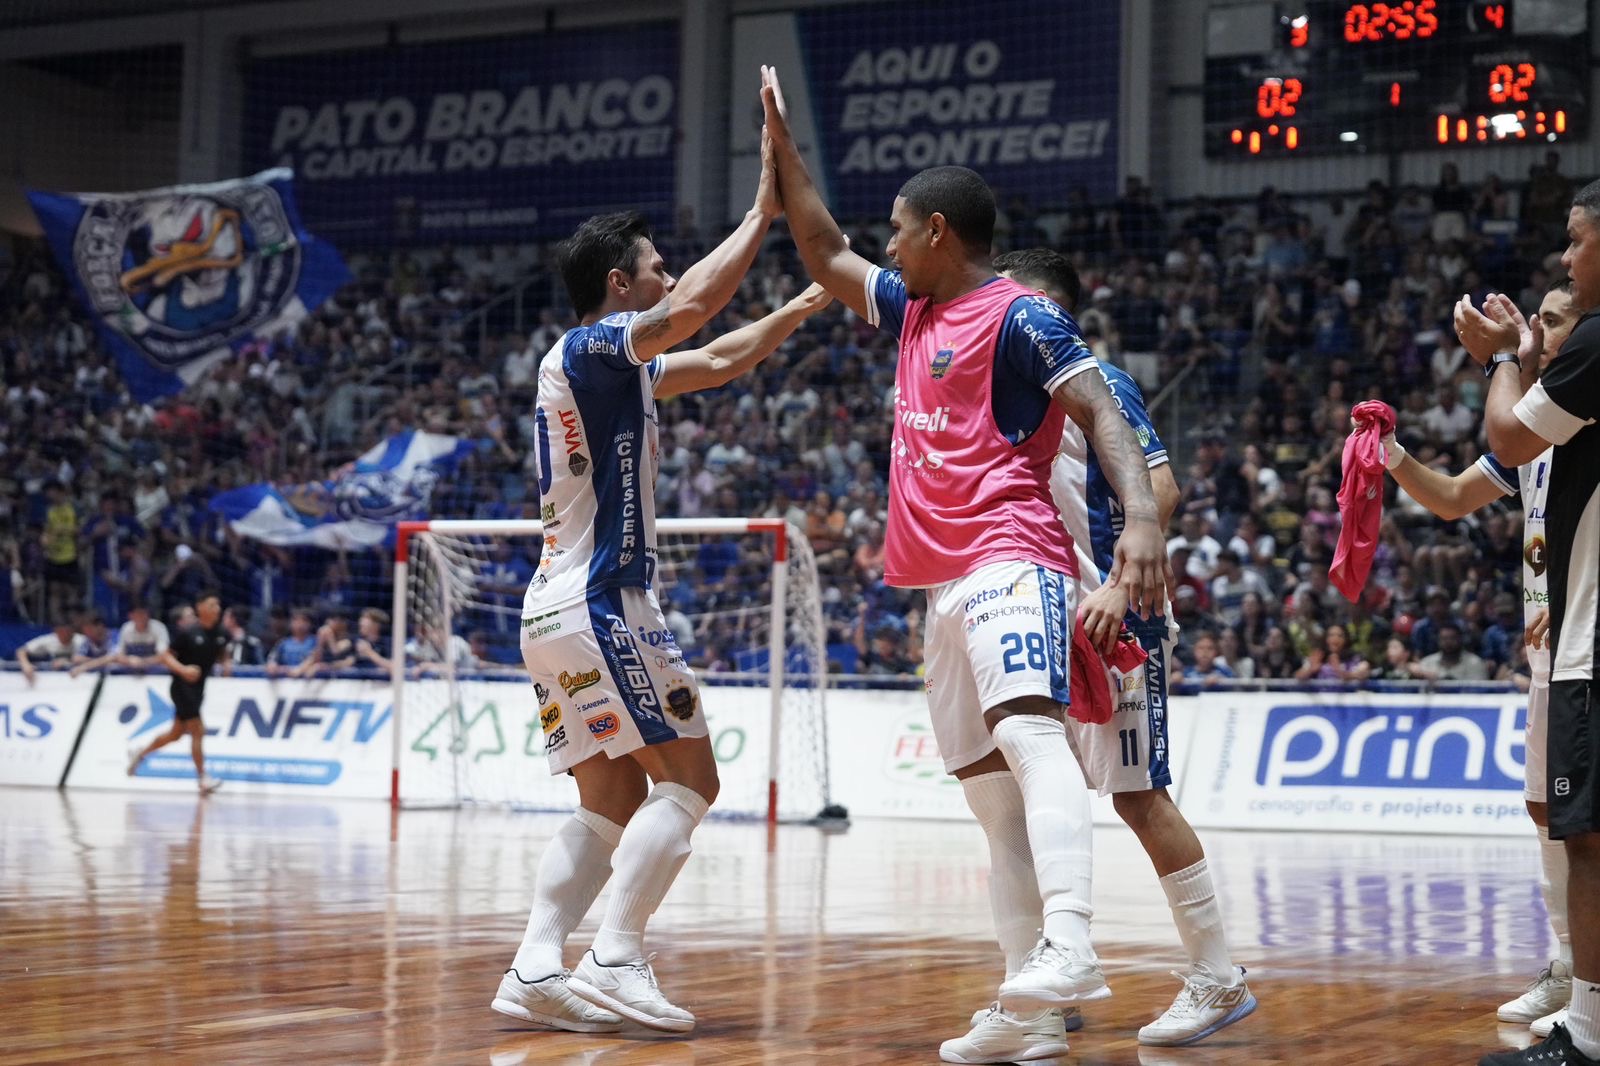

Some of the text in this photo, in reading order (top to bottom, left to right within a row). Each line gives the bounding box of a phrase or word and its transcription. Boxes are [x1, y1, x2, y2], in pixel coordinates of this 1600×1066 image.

[1345, 0, 1437, 42] 02:55
[1485, 5, 1504, 29] 4
[841, 40, 1001, 86] AQUI O
[1488, 63, 1535, 103] 02
[271, 75, 674, 152] PATO BRANCO
[841, 79, 1054, 131] ESPORTE
[1258, 77, 1302, 117] 02
[1391, 82, 1400, 106] 1
[303, 144, 436, 179] CAPITAL
[445, 138, 497, 171] DO
[502, 127, 673, 165] ESPORTE!
[839, 120, 1109, 172] ACONTECE!
[614, 430, 634, 444] escola
[617, 441, 636, 549] CRESCER
[536, 622, 562, 637] Branco
[1000, 632, 1047, 674] 28
[202, 697, 394, 743] NFTV
[582, 697, 610, 712] SANEPAR
[589, 717, 615, 734] ASC
[1119, 729, 1138, 766] 11
[1248, 795, 1354, 815] cenografia
[1362, 801, 1374, 812] e
[1381, 796, 1464, 817] projetos
